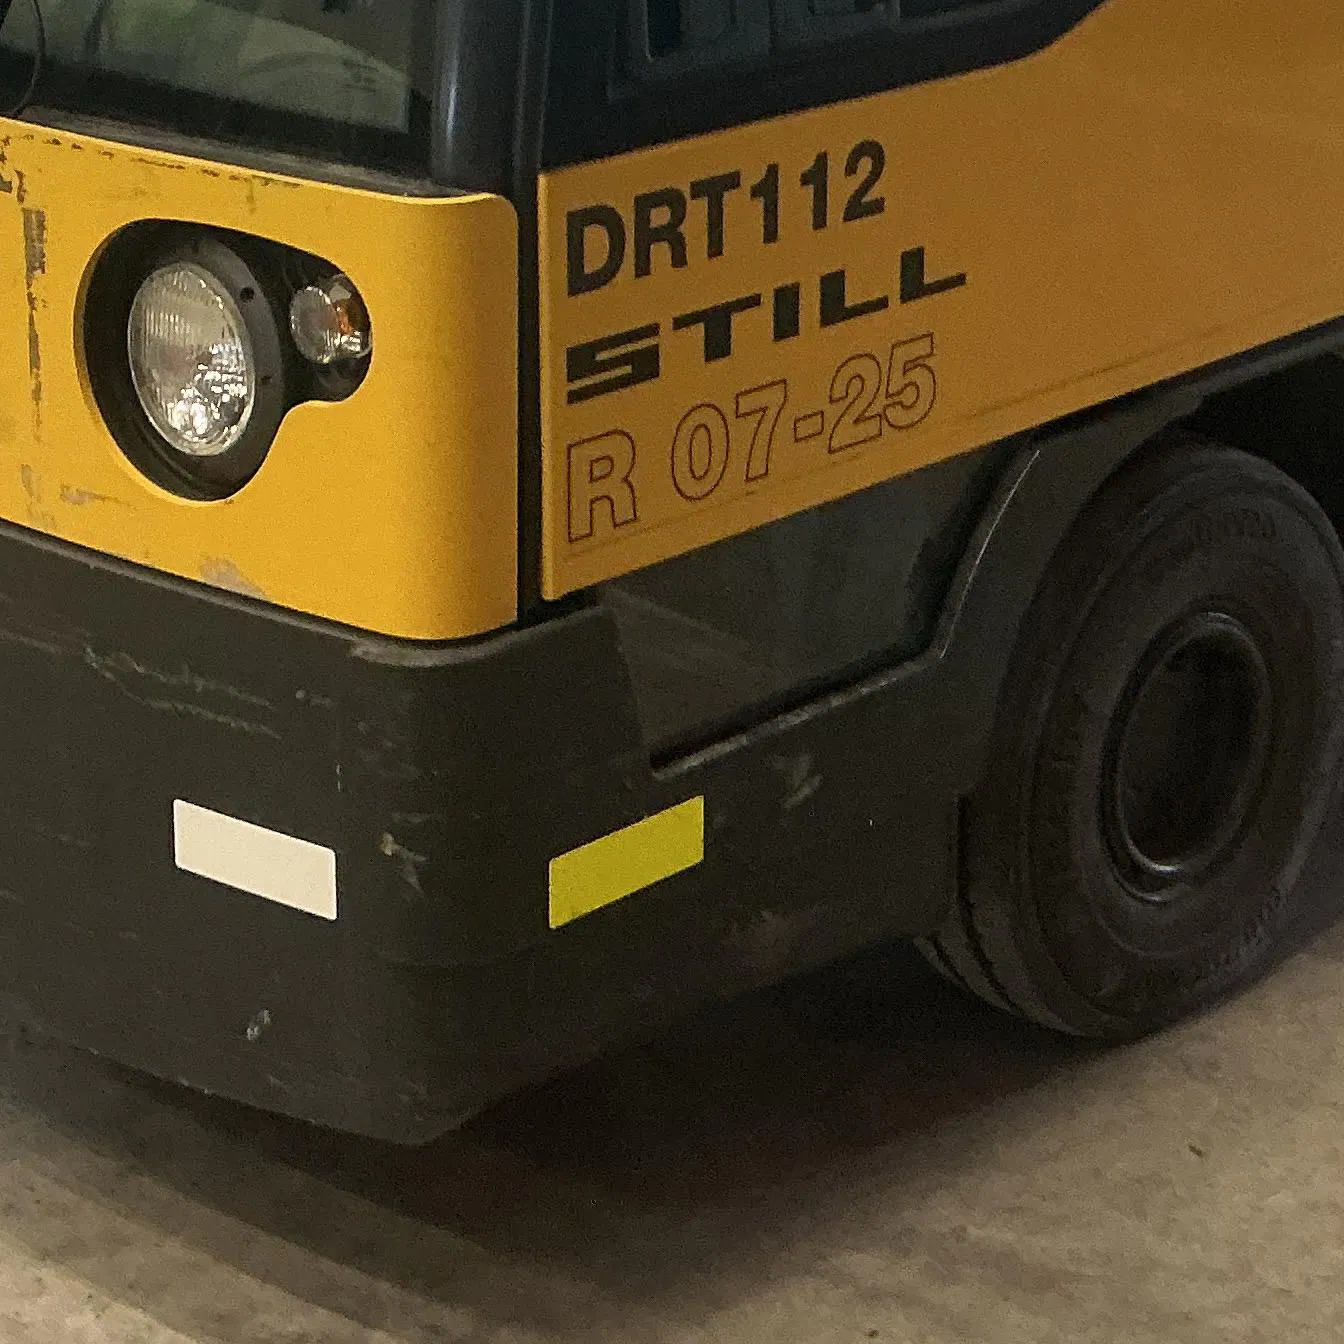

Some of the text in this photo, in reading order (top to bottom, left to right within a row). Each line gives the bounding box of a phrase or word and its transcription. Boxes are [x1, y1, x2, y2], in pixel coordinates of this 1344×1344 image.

[566, 139, 886, 298] DRT112
[566, 246, 967, 405] STILL
[567, 332, 937, 544] R 07-25
